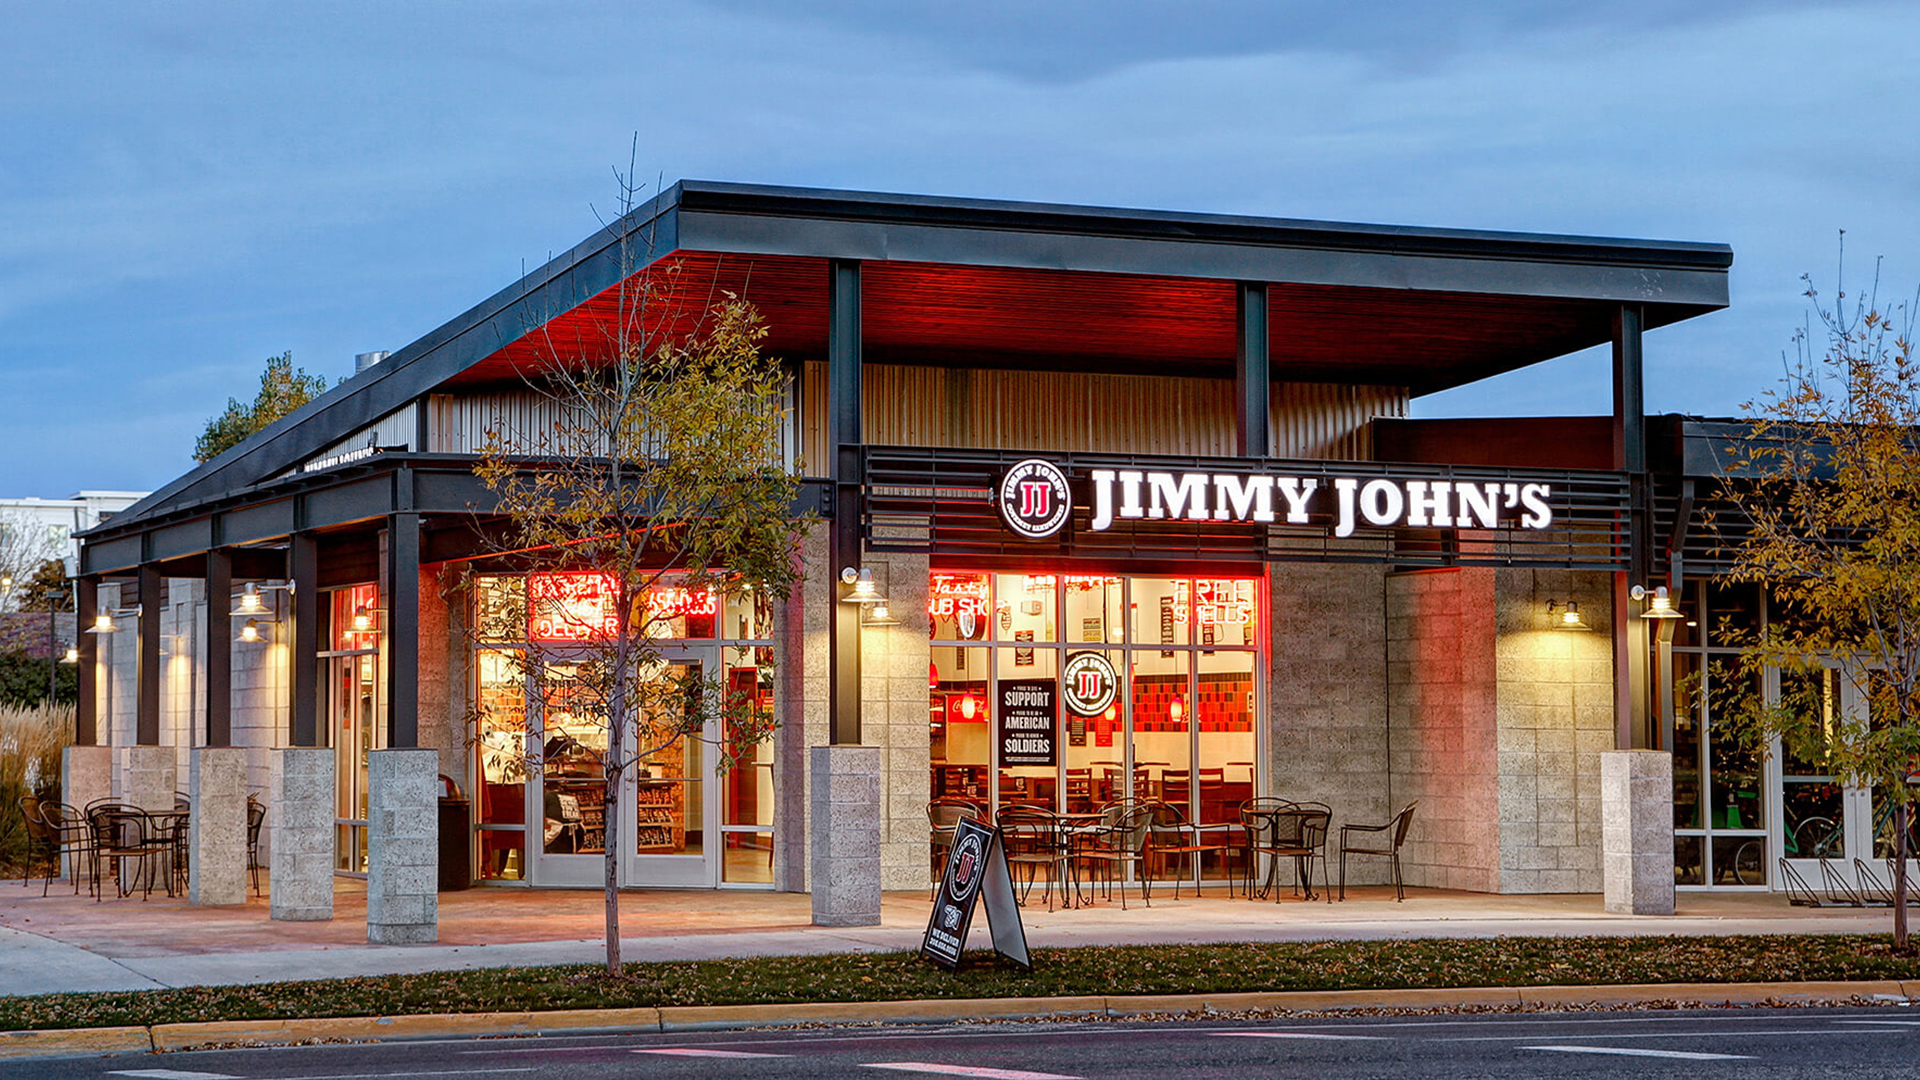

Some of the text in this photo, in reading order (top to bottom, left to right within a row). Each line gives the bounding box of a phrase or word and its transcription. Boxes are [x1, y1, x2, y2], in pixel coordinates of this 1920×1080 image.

[1005, 465, 1033, 499] JIMMY
[1020, 481, 1051, 517] JJ
[1091, 469, 1553, 538] JIMMY JOHN'S
[933, 575, 988, 599] Tasty
[1173, 580, 1250, 605] FREE
[1077, 671, 1102, 699] JJ
[1005, 691, 1050, 707] SUPPORT
[1005, 716, 1050, 730] AMERICAN
[1005, 739, 1050, 753] SOLDIERS
[956, 852, 975, 885] JJ
